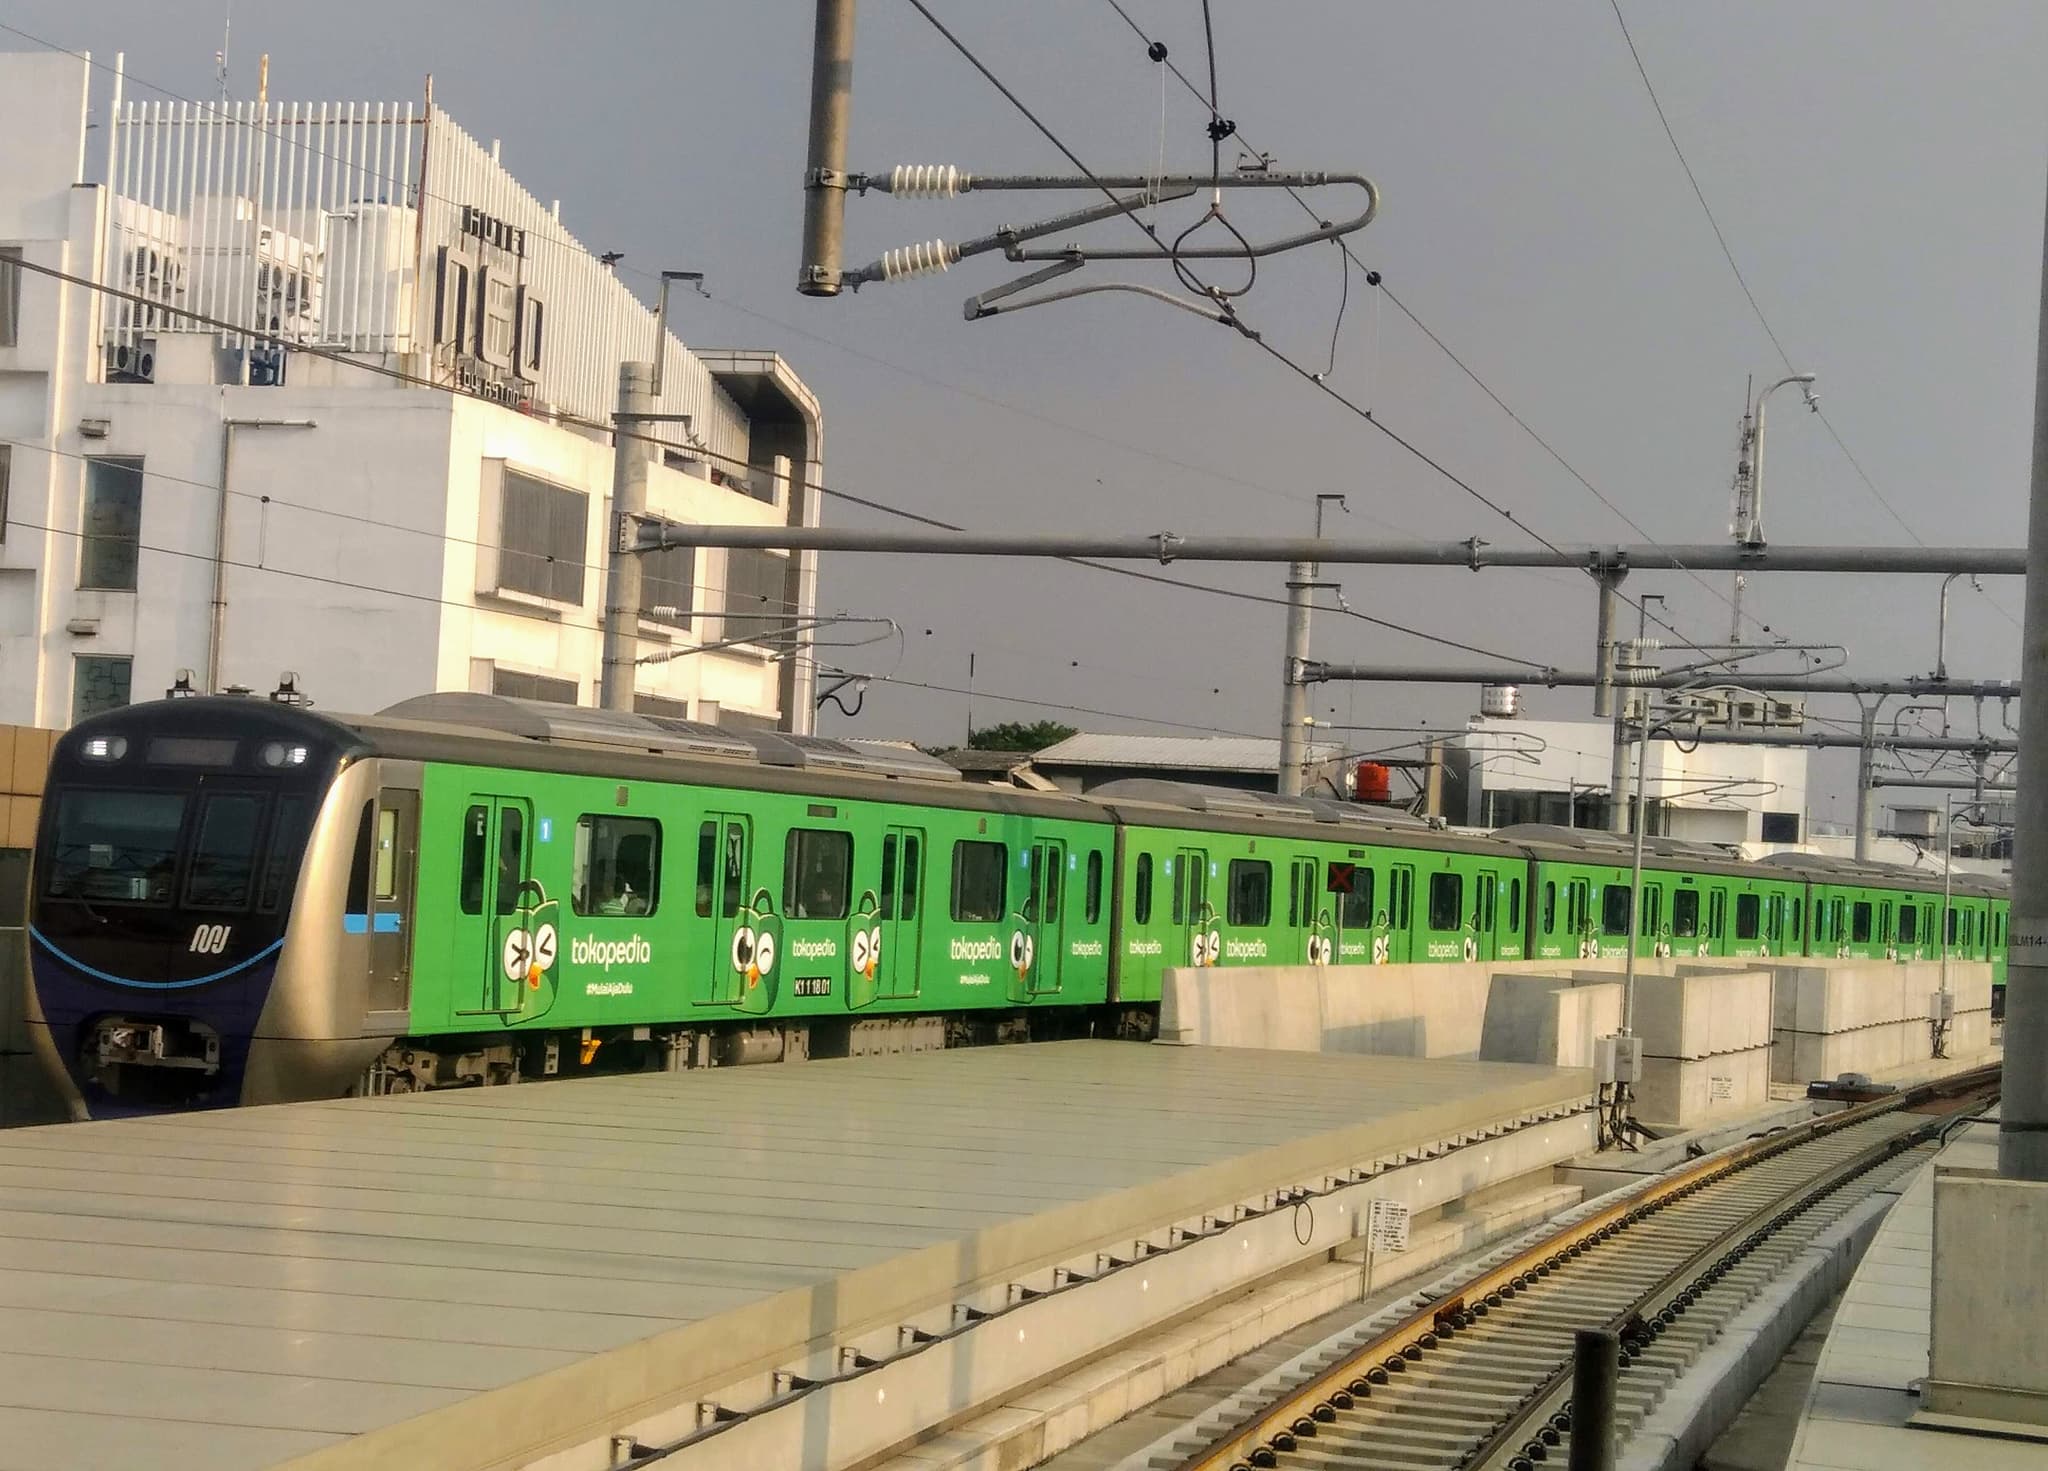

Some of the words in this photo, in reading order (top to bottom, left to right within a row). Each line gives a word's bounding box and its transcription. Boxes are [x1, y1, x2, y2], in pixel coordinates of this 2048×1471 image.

[572, 933, 651, 972] tokopedia
[793, 938, 836, 961] tokopedia
[951, 935, 1002, 966] tokopedia
[1072, 940, 1102, 958] tokopedia
[1129, 939, 1162, 957] tokopedia
[1226, 937, 1268, 962] tokopedia
